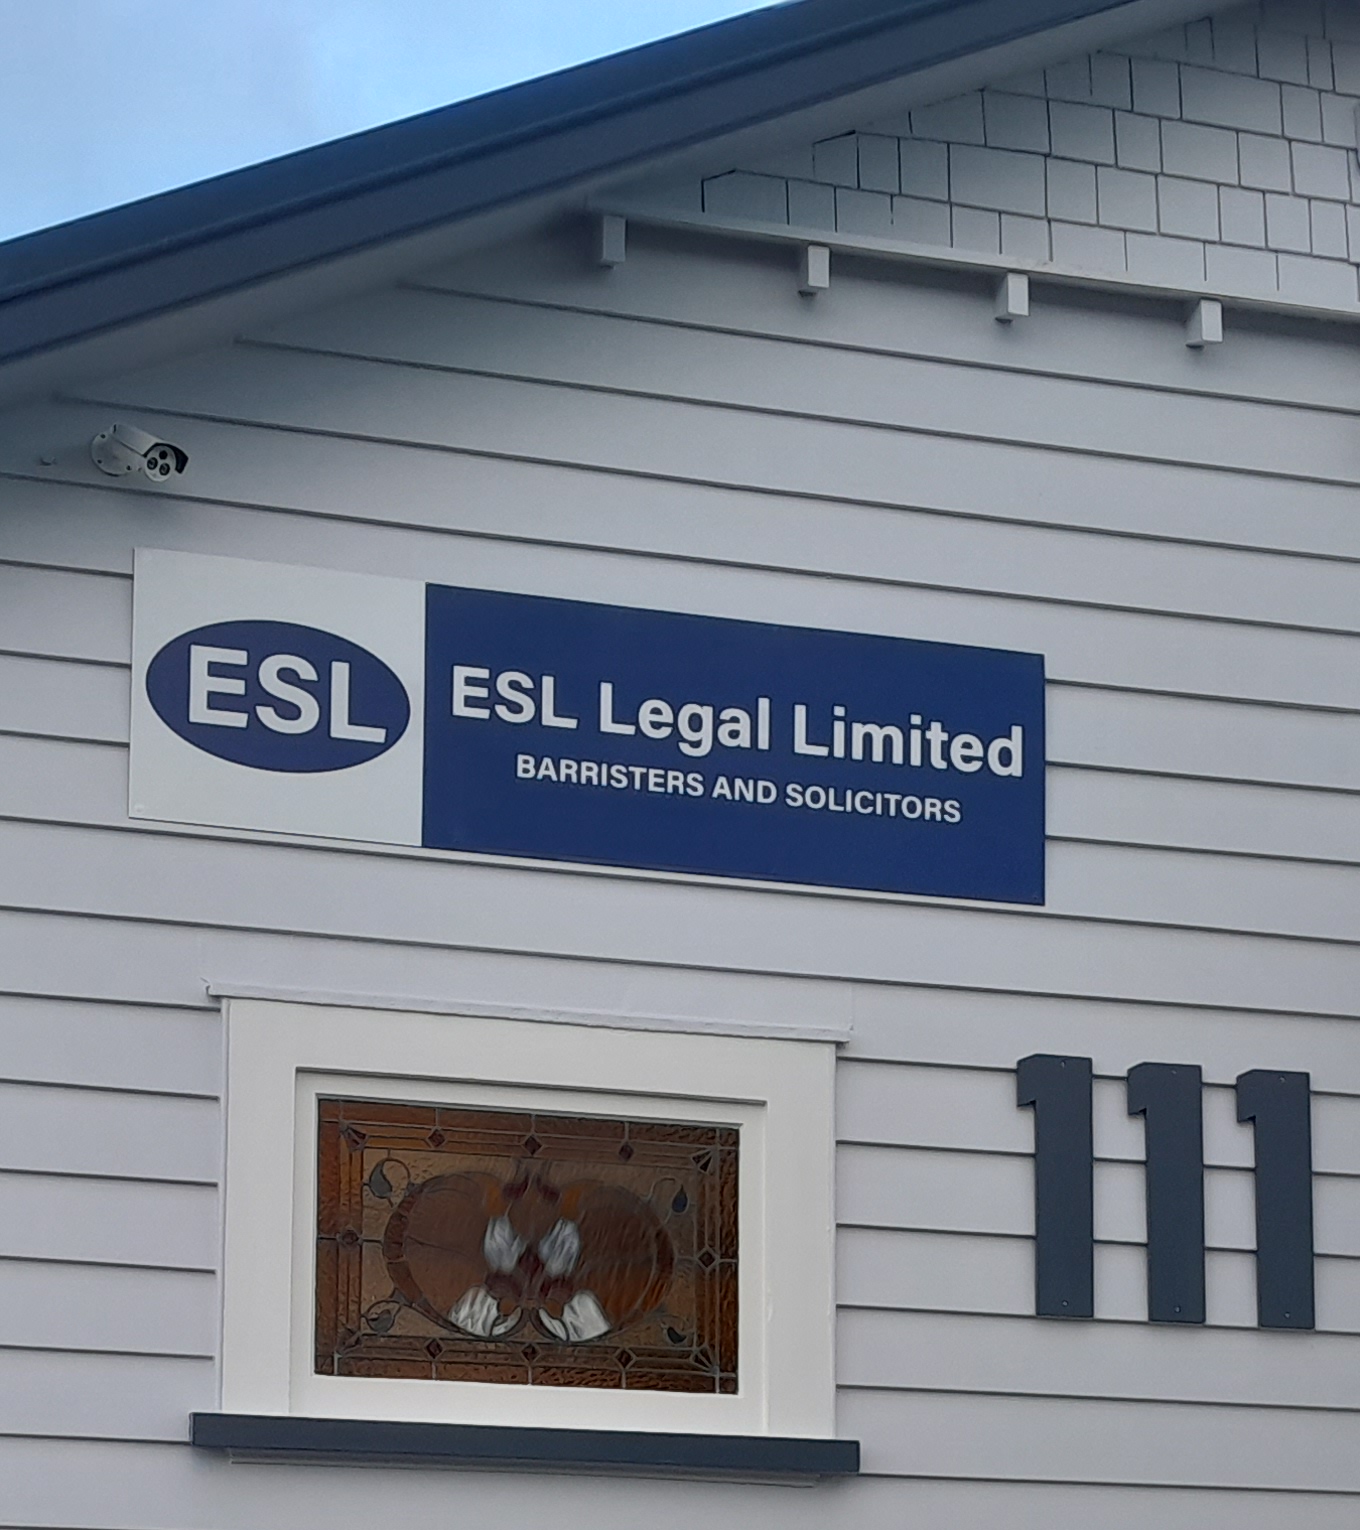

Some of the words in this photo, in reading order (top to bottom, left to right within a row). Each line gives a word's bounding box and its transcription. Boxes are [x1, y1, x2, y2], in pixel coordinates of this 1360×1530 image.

[188, 643, 388, 744] ESL
[451, 664, 578, 729] ESL
[599, 681, 770, 758] Legal
[793, 703, 1024, 778] Limited
[516, 753, 705, 798] BARRISTERS
[711, 775, 778, 805] AND
[784, 782, 962, 824] SOLICITORS
[1016, 1053, 1316, 1330] 111
